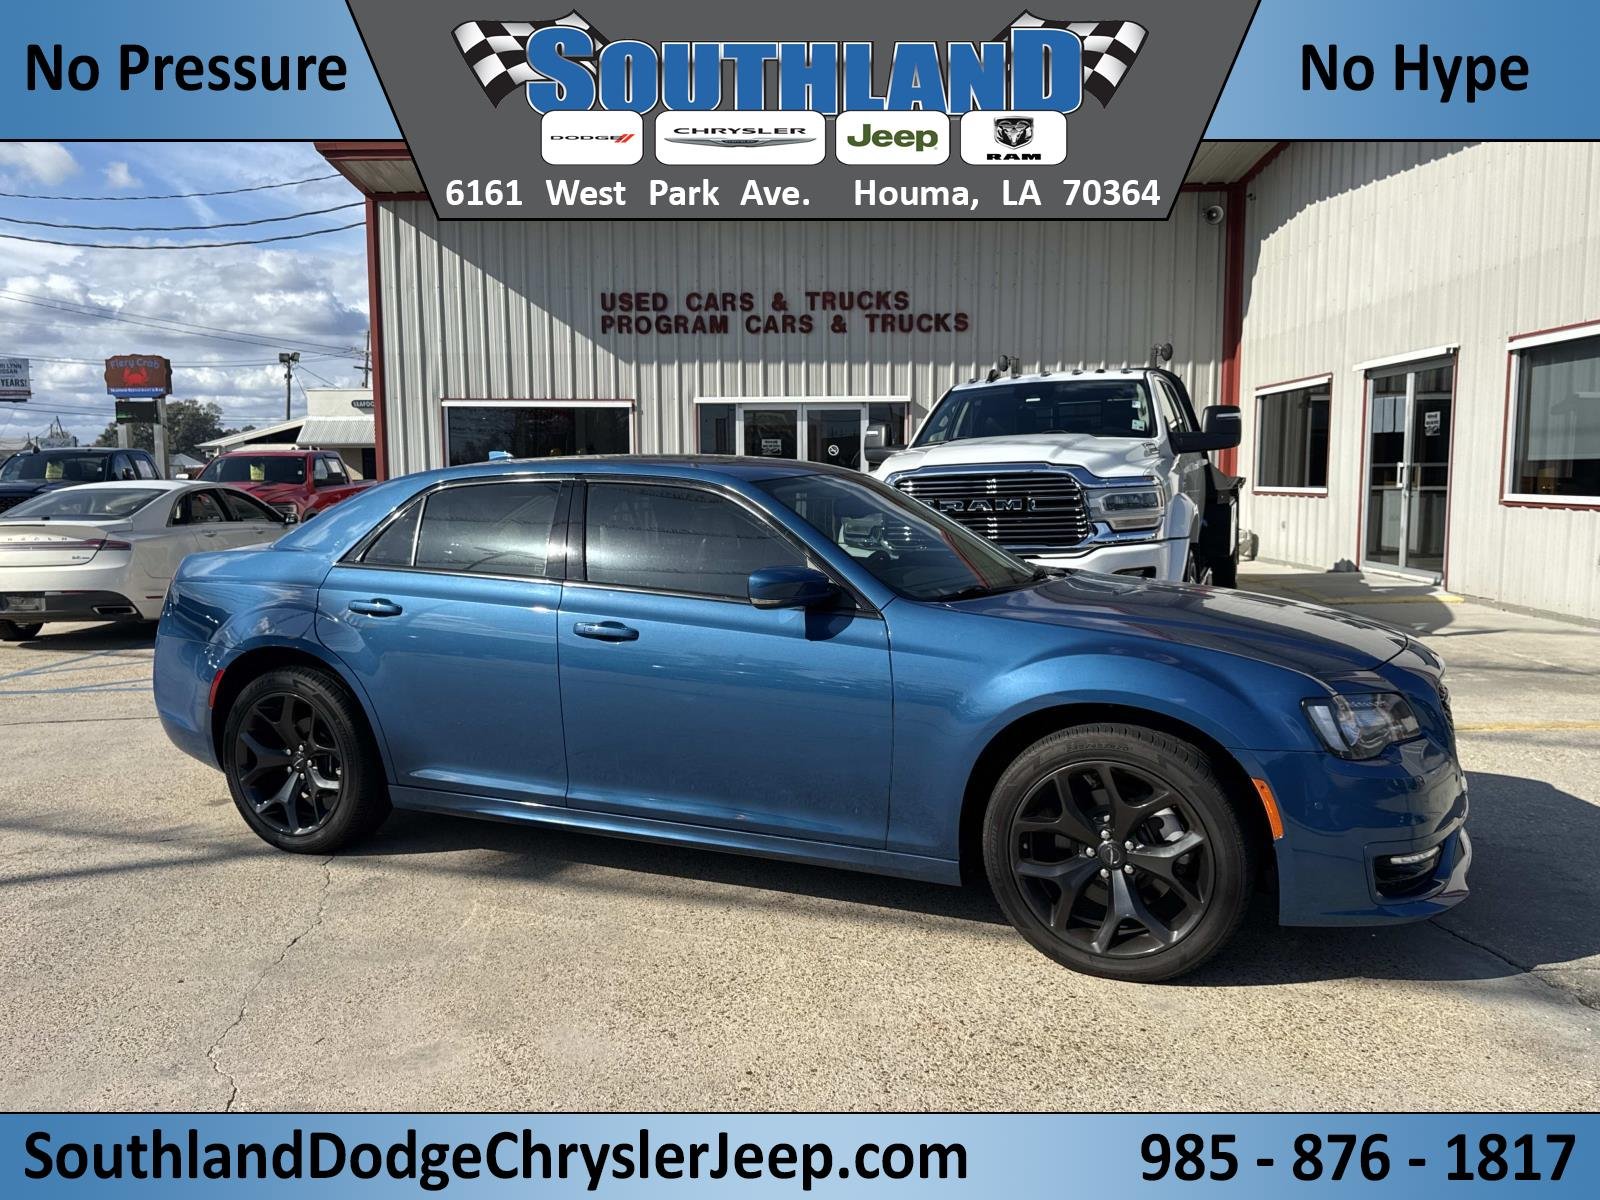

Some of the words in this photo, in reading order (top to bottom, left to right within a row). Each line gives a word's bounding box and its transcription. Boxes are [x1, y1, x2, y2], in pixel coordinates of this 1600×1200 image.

[601, 292, 668, 312] USED
[685, 292, 754, 312] CARS
[771, 292, 788, 311] &
[805, 290, 909, 311] TRUCKS
[601, 315, 728, 334] PROGRAM
[745, 315, 813, 334] CARS
[830, 314, 847, 334] &
[865, 313, 969, 333] TRUCKS
[1, 379, 27, 387] YEARS!
[940, 500, 1023, 512] RAM
